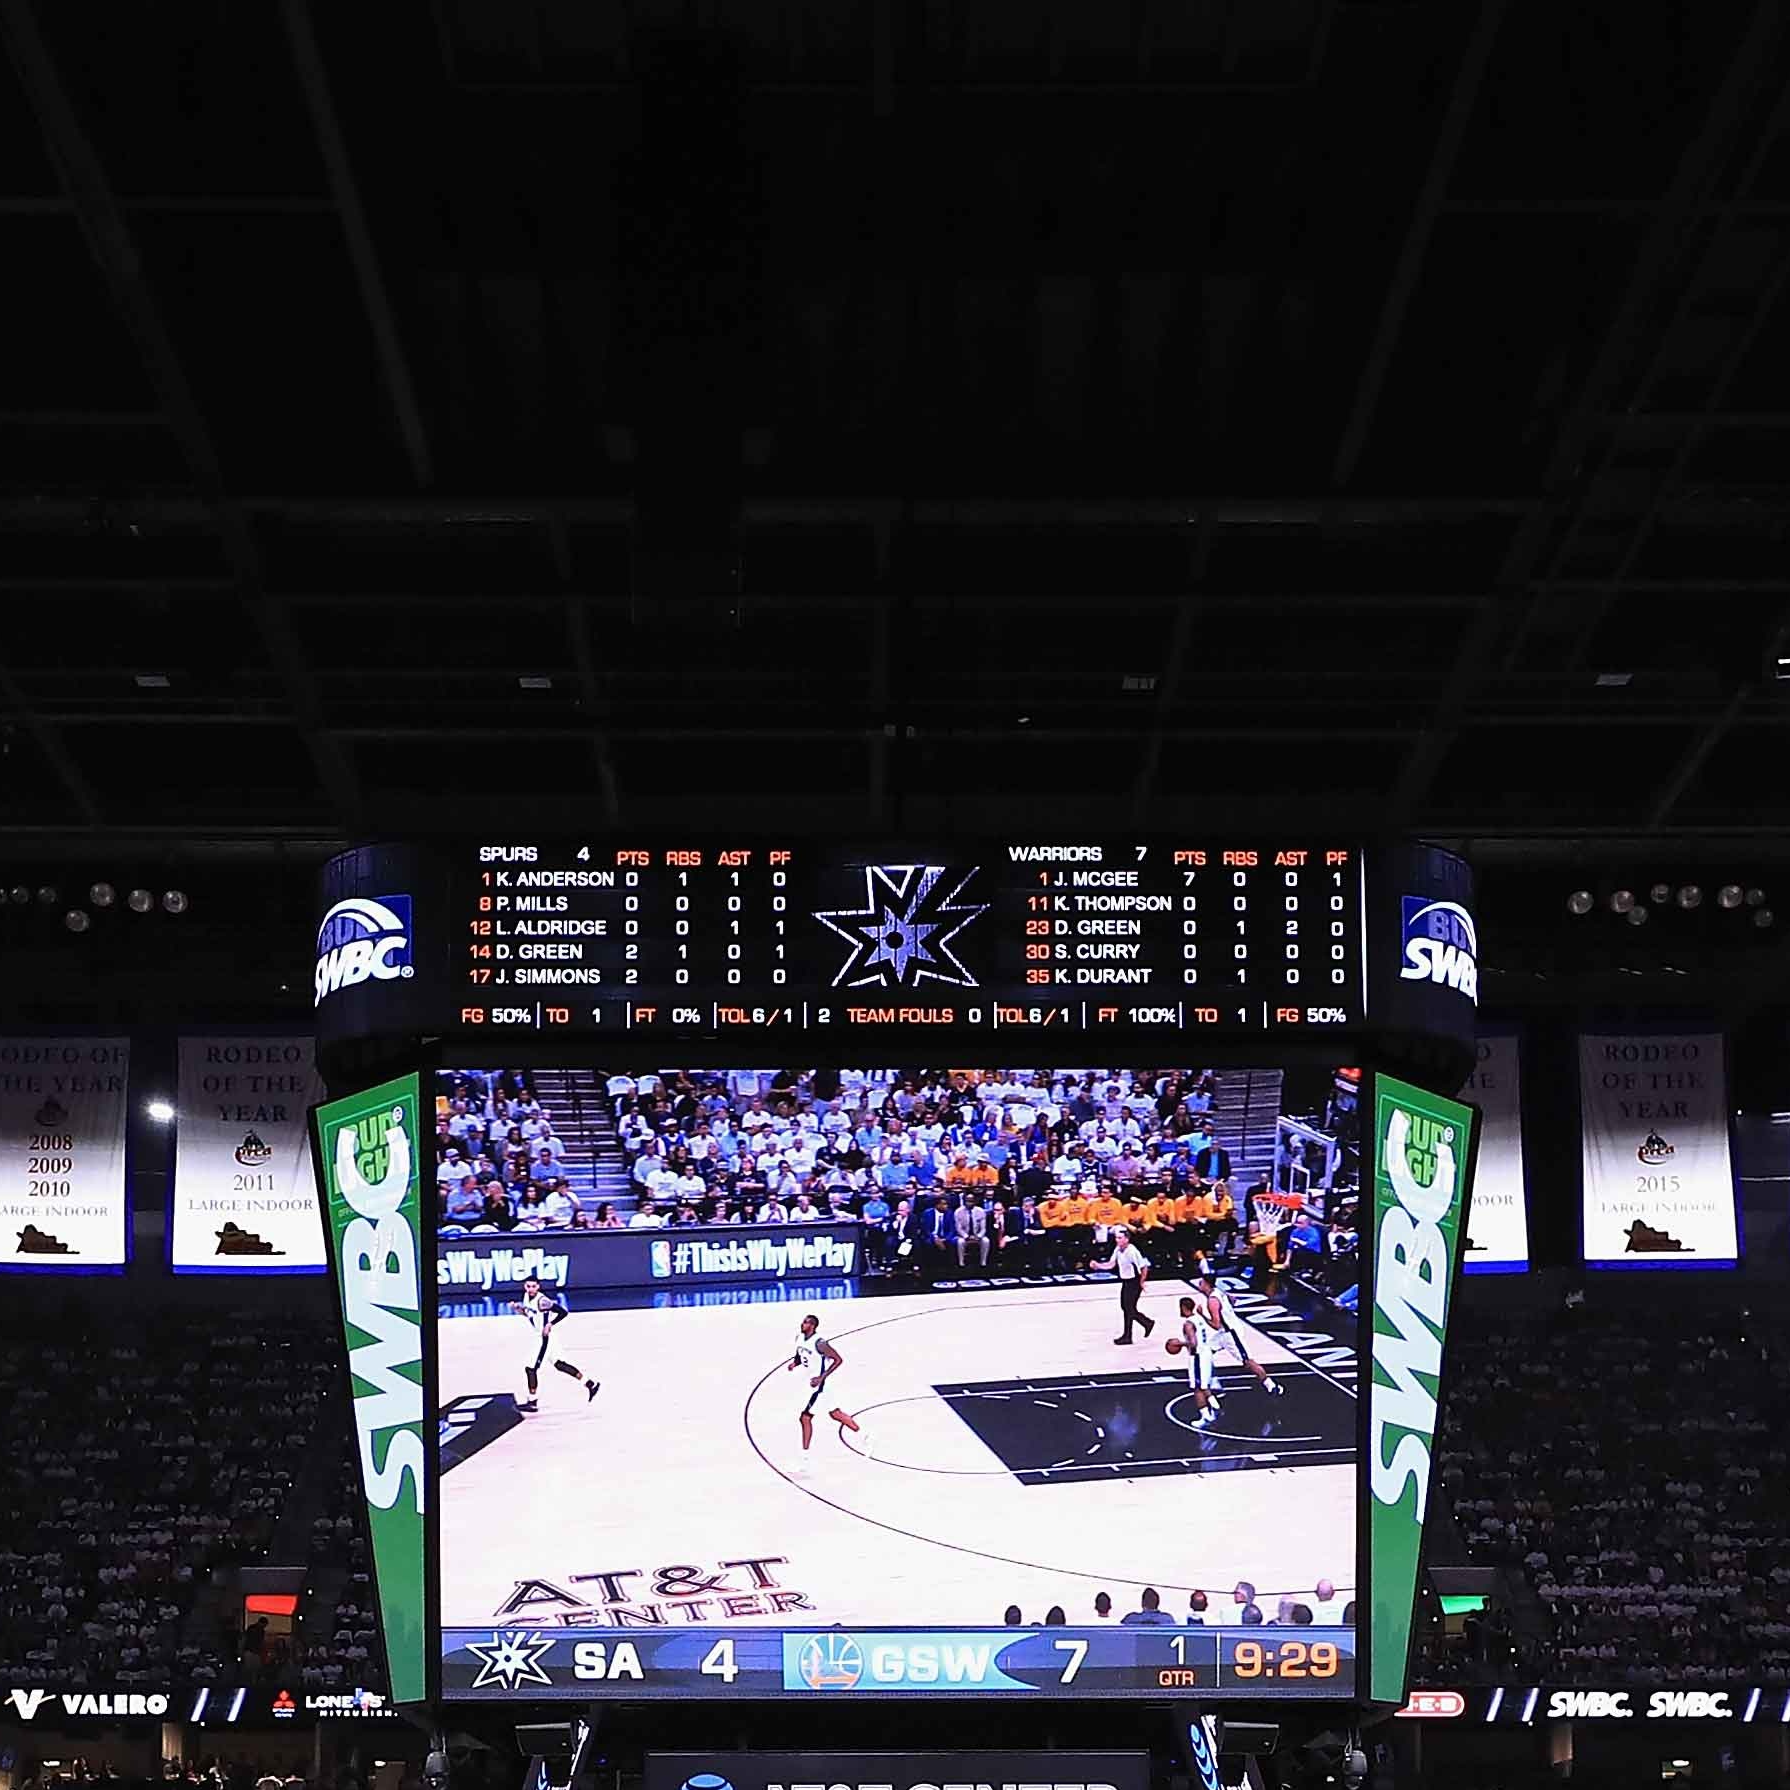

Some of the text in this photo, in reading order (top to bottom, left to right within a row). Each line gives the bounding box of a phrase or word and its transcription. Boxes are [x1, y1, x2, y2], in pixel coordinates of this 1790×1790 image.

[480, 846, 591, 862] SPURS 4
[616, 850, 792, 866] PTS RBS AST PF
[1008, 846, 1148, 862] WARRIORS 7
[1173, 850, 1348, 866] PTS RBS AST PF
[481, 871, 615, 887] 1 K. ANDERSON
[1039, 871, 1139, 887] 1 J. MCGEE
[479, 895, 569, 912] 8 P. MILLS
[1027, 895, 1173, 912] 11 K. THOMPSON
[469, 919, 607, 936] 12 L. ALDRIDGE
[1025, 919, 1141, 936] 23 D. GREEN
[469, 943, 583, 960] 14 D. GREEN
[1025, 943, 1141, 960] 30 S. CURRY
[469, 968, 601, 985] 17 J. SIMMONS
[1026, 968, 1153, 984] 35 K. DURANT
[846, 1007, 954, 1023] TEAM FOULS
[28, 1133, 74, 1152] 2008
[27, 1155, 74, 1175] 2009
[27, 1179, 72, 1198] 2010
[232, 1173, 275, 1193] 2011
[1635, 1174, 1682, 1193] 2015
[188, 1198, 315, 1212] LARGE INDOOR
[336, 1125, 426, 1516] SWBC
[1370, 1108, 1459, 1526] SWBC
[493, 1556, 790, 1618] AT&T
[573, 1634, 1187, 1683] SA 4 GSW 7 1
[1232, 1640, 1340, 1679] 9:29
[1157, 1668, 1195, 1687] QTR
[62, 1693, 168, 1715] VALERO
